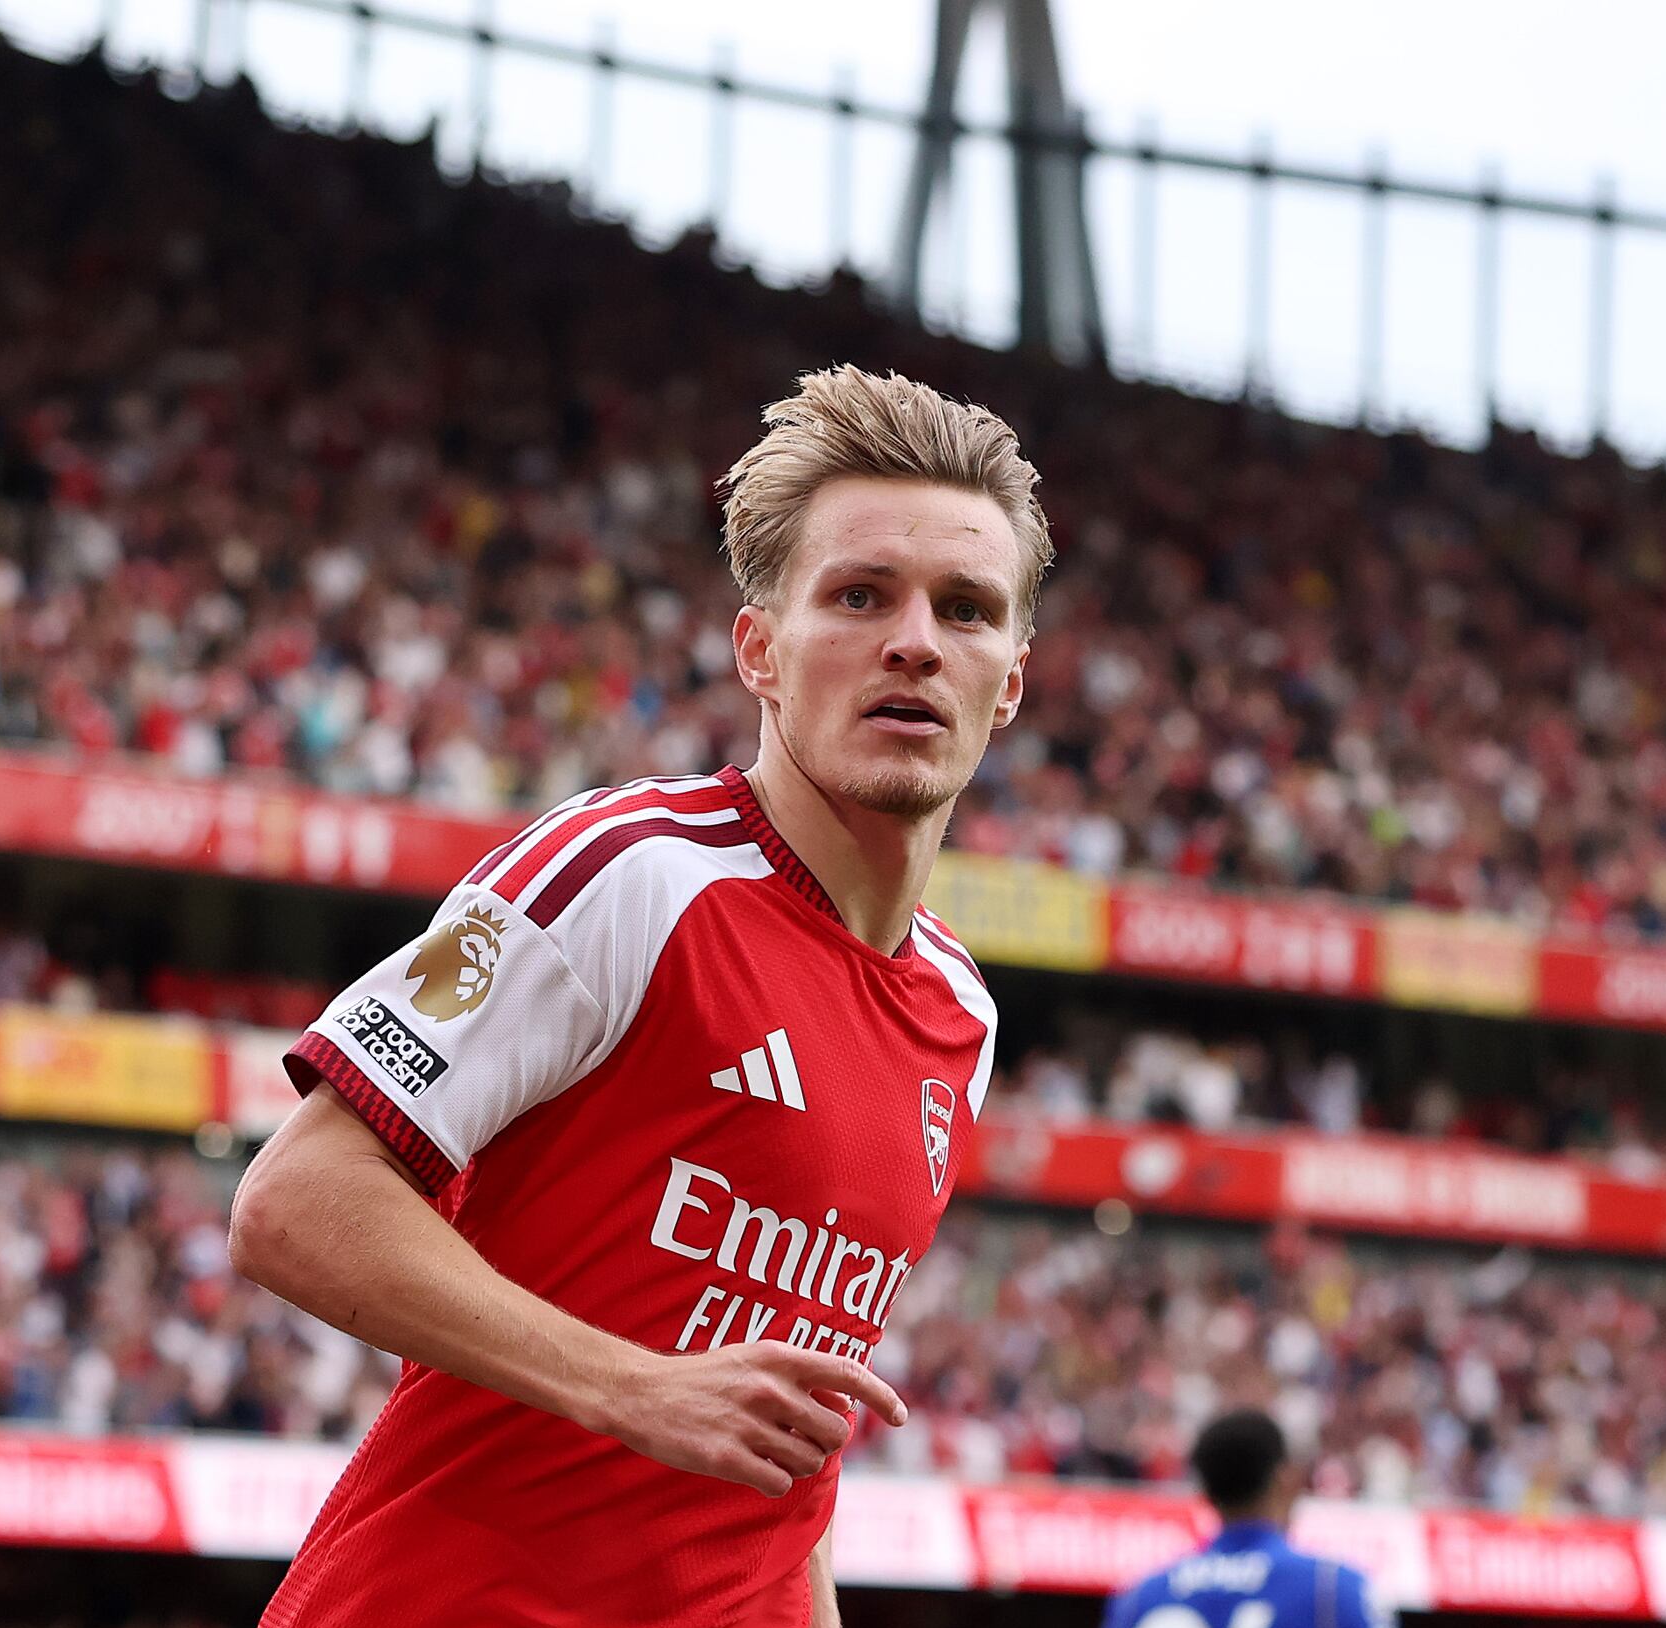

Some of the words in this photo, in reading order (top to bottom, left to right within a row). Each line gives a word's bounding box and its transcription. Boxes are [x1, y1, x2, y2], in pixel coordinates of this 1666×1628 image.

[334, 1007, 371, 1034] for
[360, 1032, 428, 1098] racism
[350, 997, 385, 1024] No
[378, 1020, 434, 1075] room
[650, 1156, 912, 1330] Emirat
